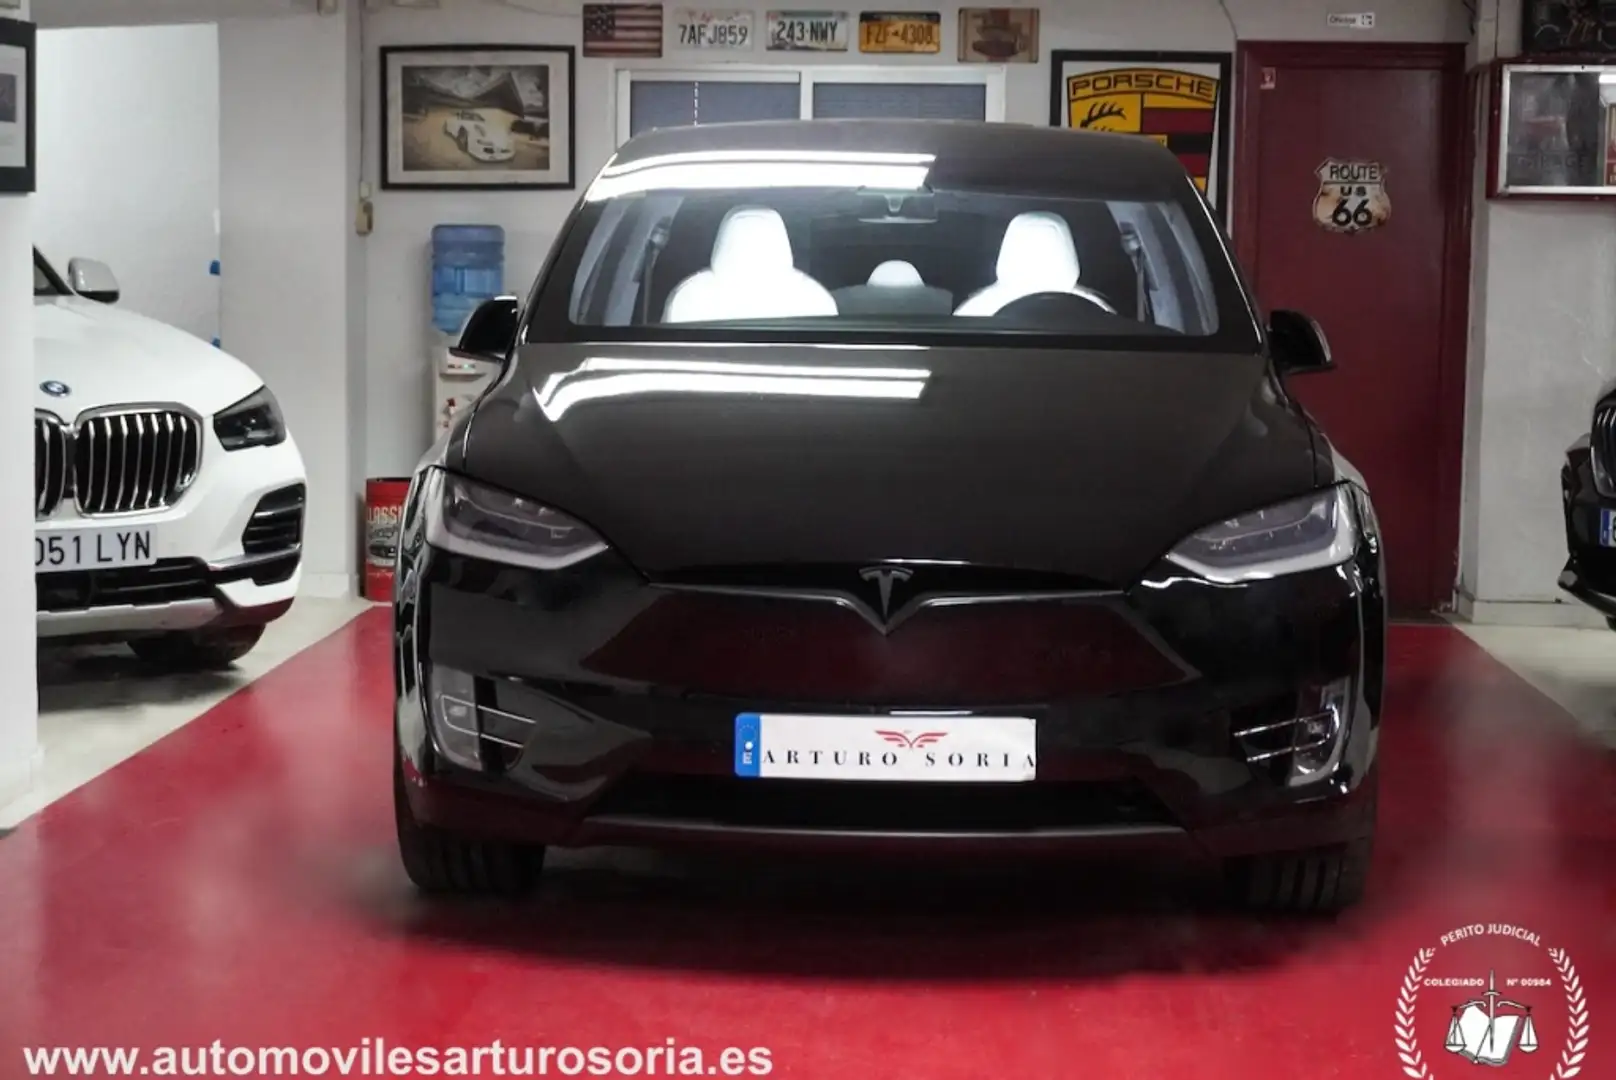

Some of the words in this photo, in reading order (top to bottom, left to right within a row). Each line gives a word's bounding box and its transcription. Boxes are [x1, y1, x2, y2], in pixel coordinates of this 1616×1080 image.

[678, 23, 748, 45] 7AFJ859
[1071, 74, 1213, 97] PORSCHE
[1329, 164, 1378, 181] ROUTE
[1331, 200, 1373, 227] 66
[97, 530, 150, 563] LYN
[763, 750, 897, 766] ARTURO
[925, 751, 1034, 768] SORIA
